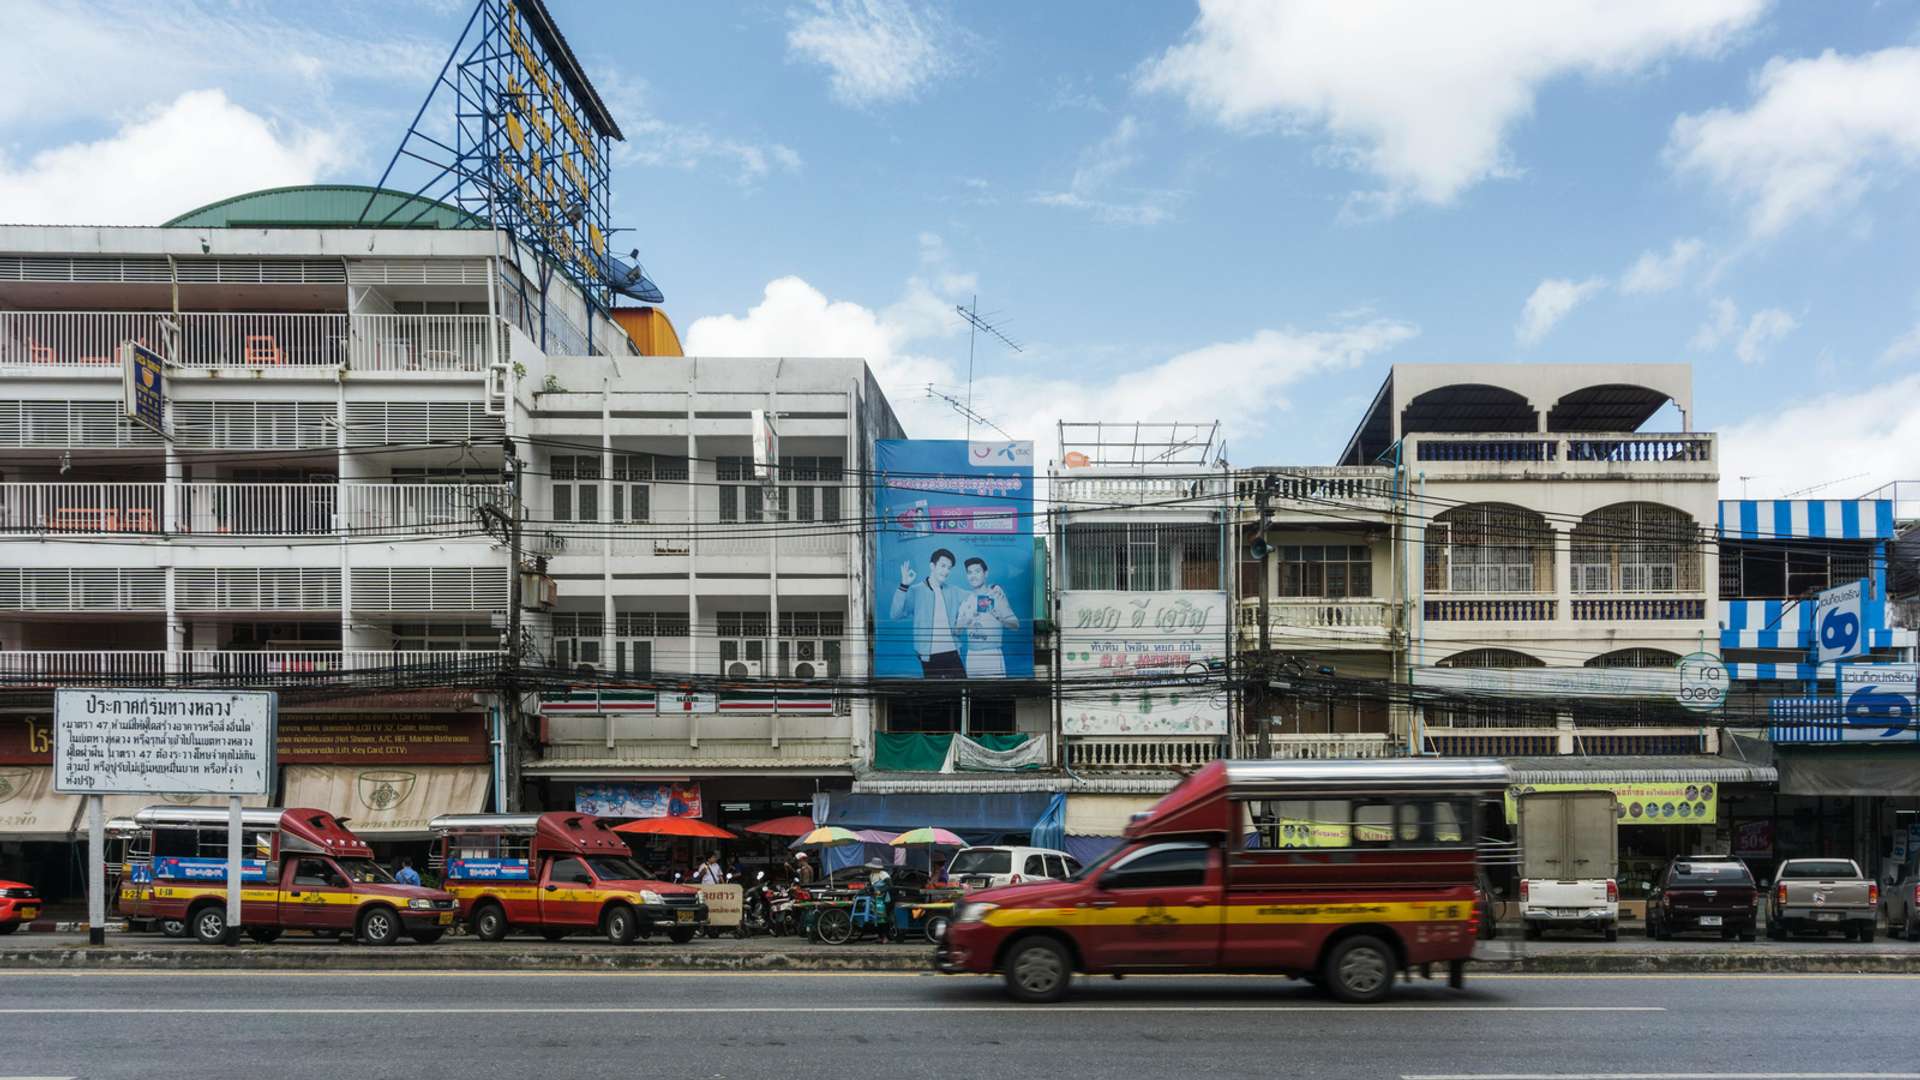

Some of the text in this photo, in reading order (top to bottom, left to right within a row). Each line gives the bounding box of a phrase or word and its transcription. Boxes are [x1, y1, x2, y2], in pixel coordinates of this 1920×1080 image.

[1076, 598, 1214, 634] หยก ดี เจริญ
[1090, 640, 1201, 653] ทับทิม ไพลิน หยก กำไล
[1680, 682, 1720, 701] bee
[86, 694, 231, 716] ประกาศกรมทางหลวง
[25, 716, 54, 753] โร
[96, 721, 108, 729] 47
[139, 750, 152, 759] 47
